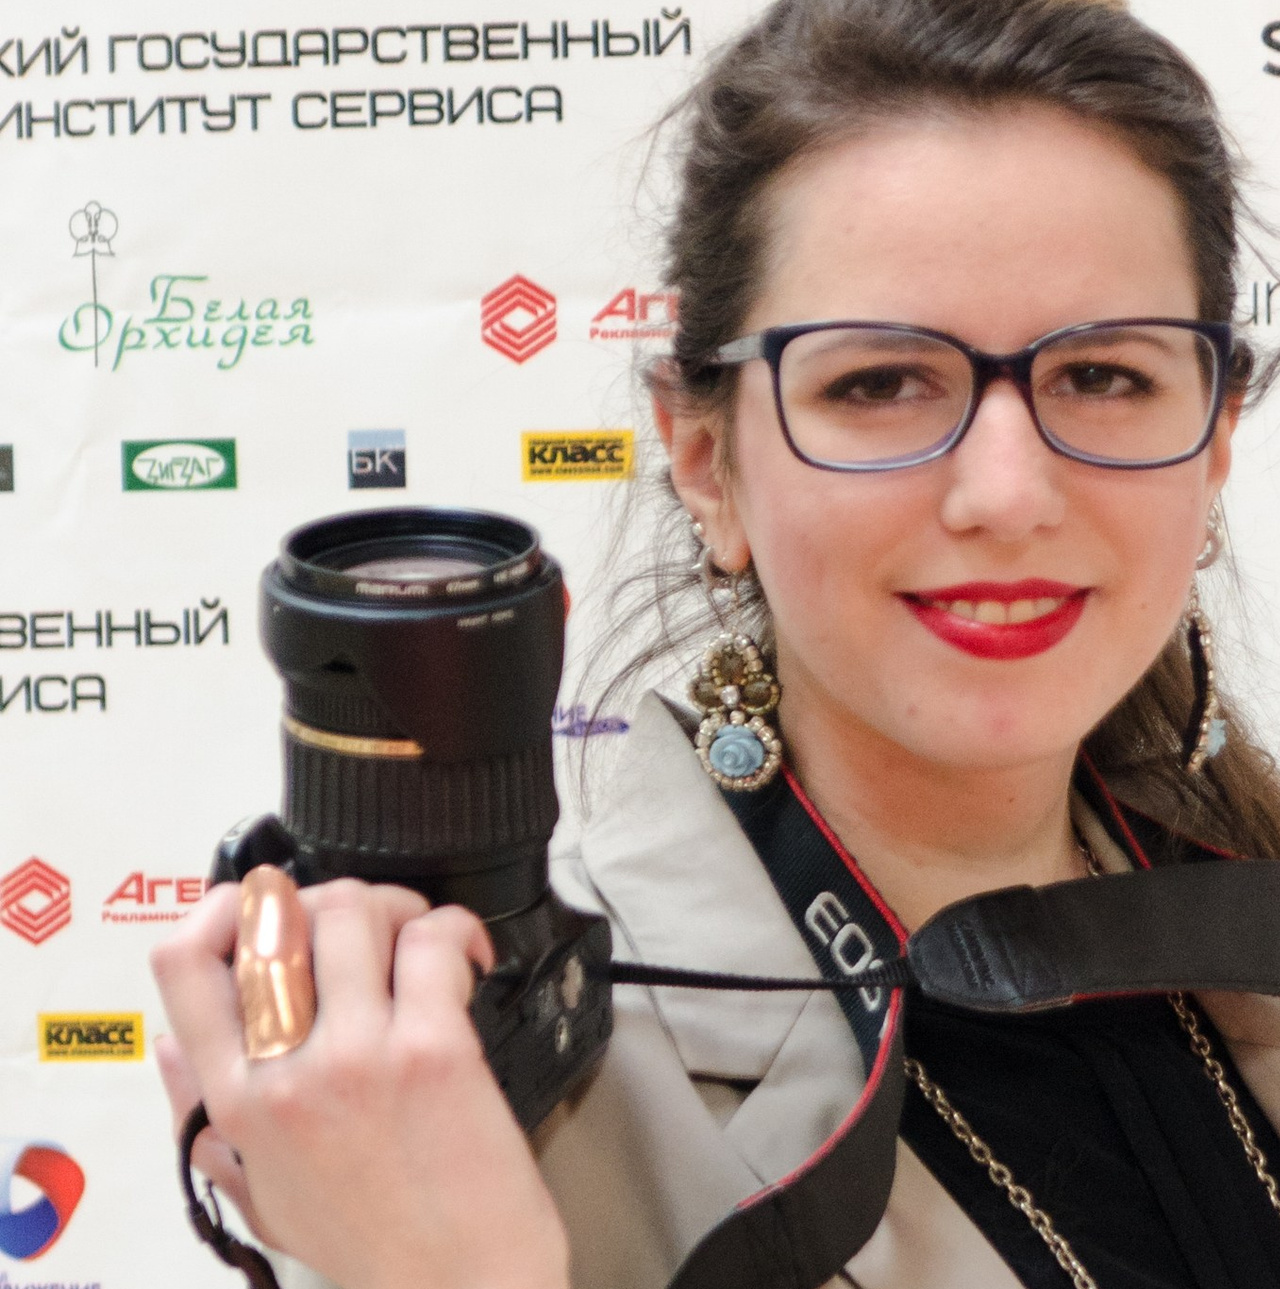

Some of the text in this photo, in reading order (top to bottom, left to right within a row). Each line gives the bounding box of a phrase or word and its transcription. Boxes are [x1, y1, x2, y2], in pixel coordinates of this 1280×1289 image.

[108, 7, 692, 74] ГОСУДАРСТВЕННЫЙ
[291, 84, 564, 131] СЕРВИСА
[351, 449, 398, 474] БК
